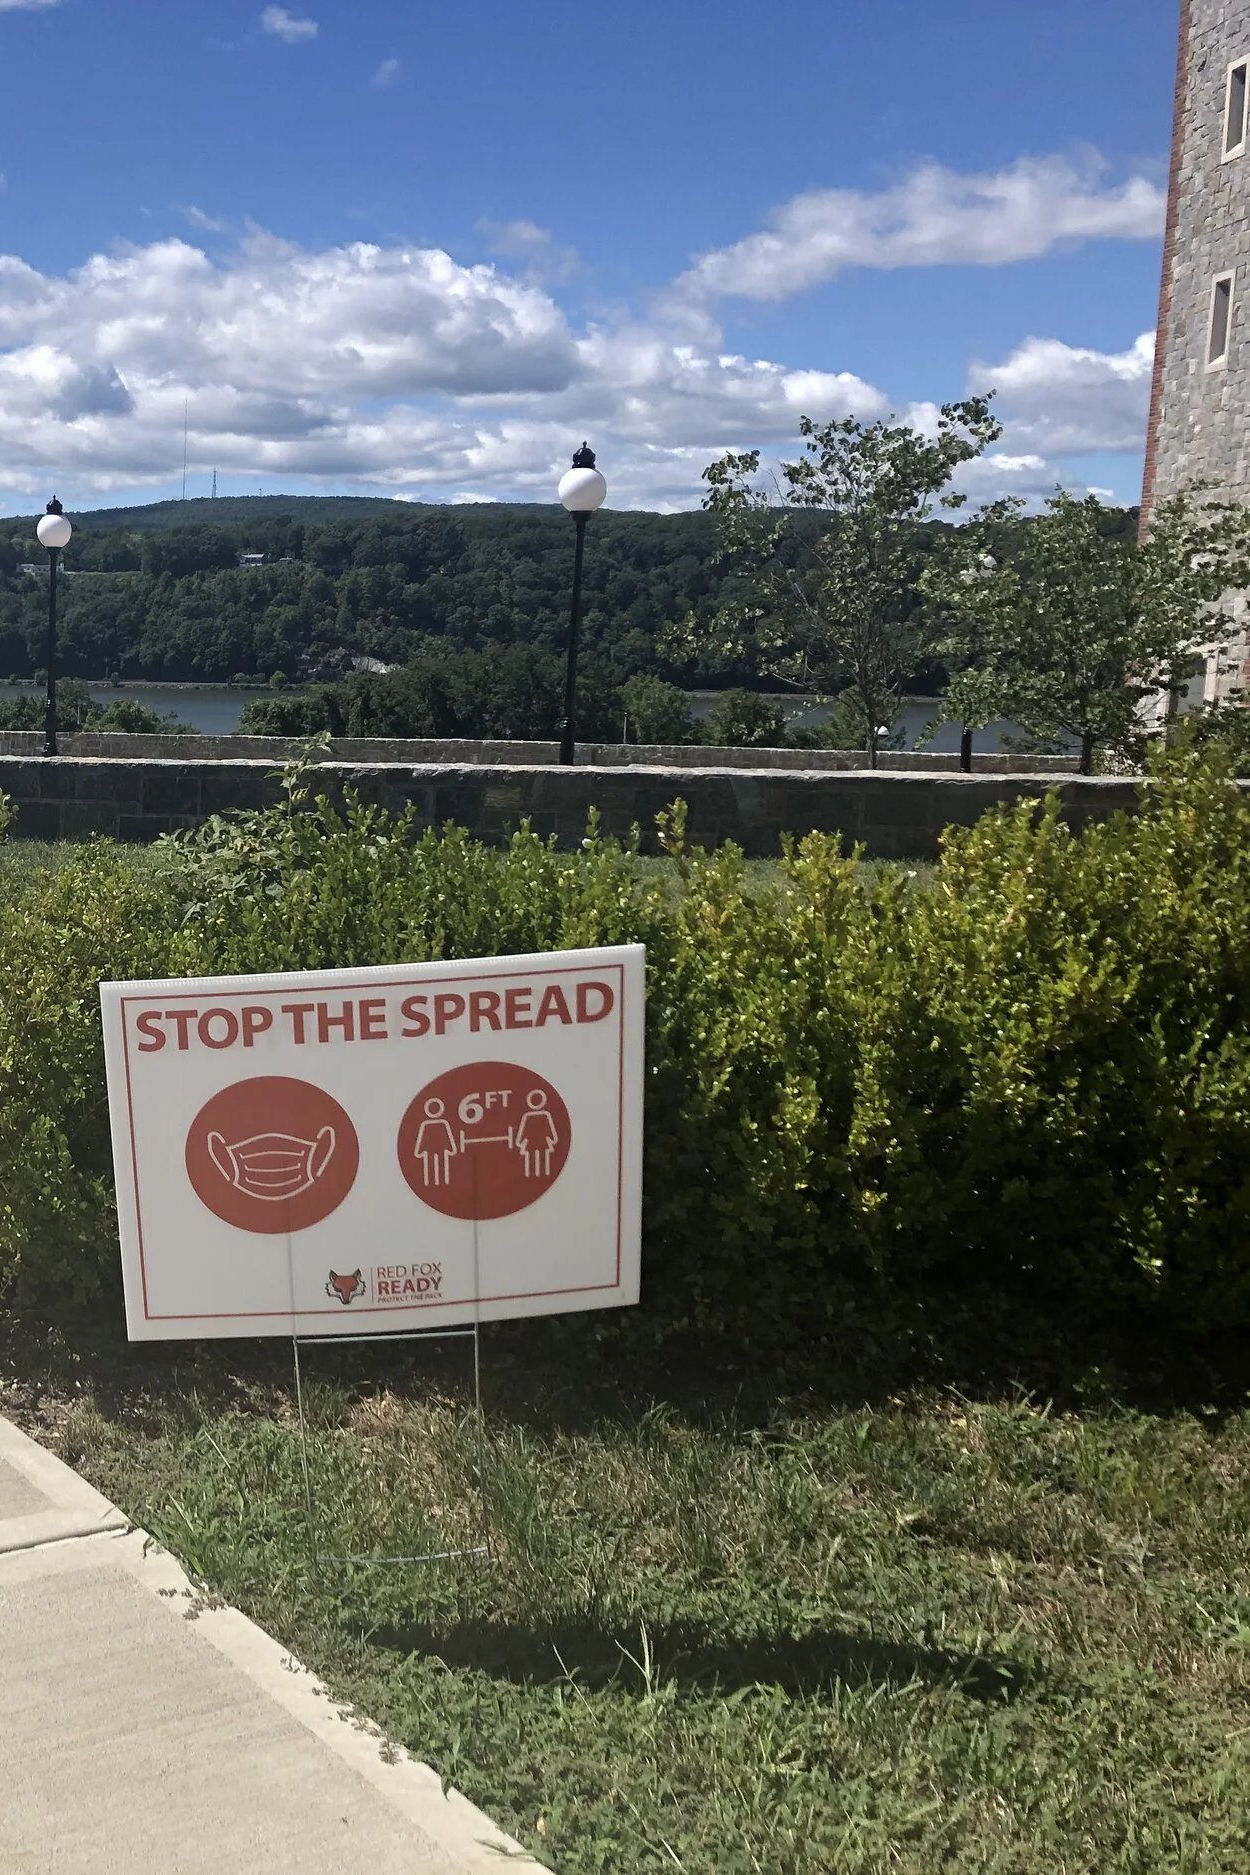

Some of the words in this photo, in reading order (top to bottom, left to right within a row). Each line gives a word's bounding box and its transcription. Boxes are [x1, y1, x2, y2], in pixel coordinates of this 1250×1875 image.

[136, 1005, 273, 1053] STOP
[281, 998, 388, 1045] THE
[400, 981, 615, 1038] SPREAD
[376, 1265, 407, 1279] RED
[411, 1262, 442, 1277] FOX
[377, 1276, 443, 1296] READY
